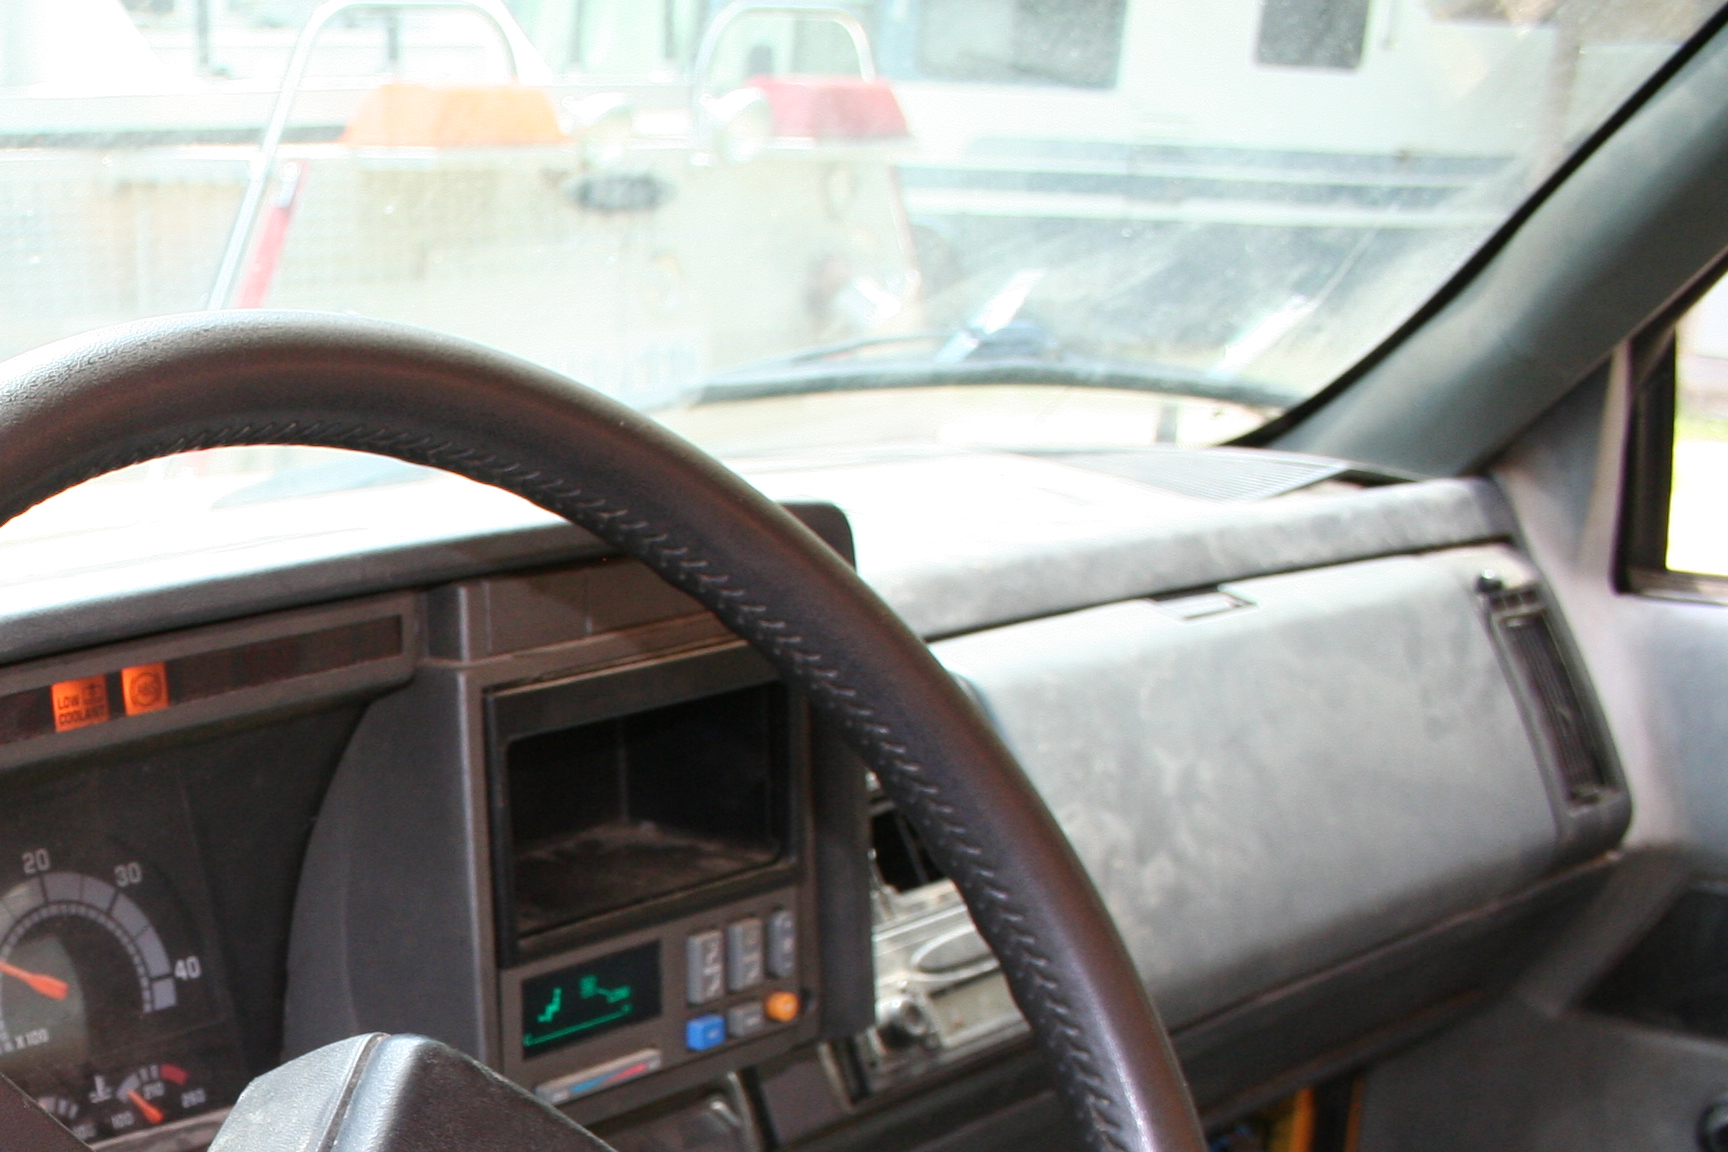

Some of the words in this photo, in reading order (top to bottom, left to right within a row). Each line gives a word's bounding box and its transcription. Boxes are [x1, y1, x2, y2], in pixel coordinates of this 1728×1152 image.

[22, 848, 50, 874] 20
[114, 861, 142, 887] 30
[174, 955, 202, 981] 40
